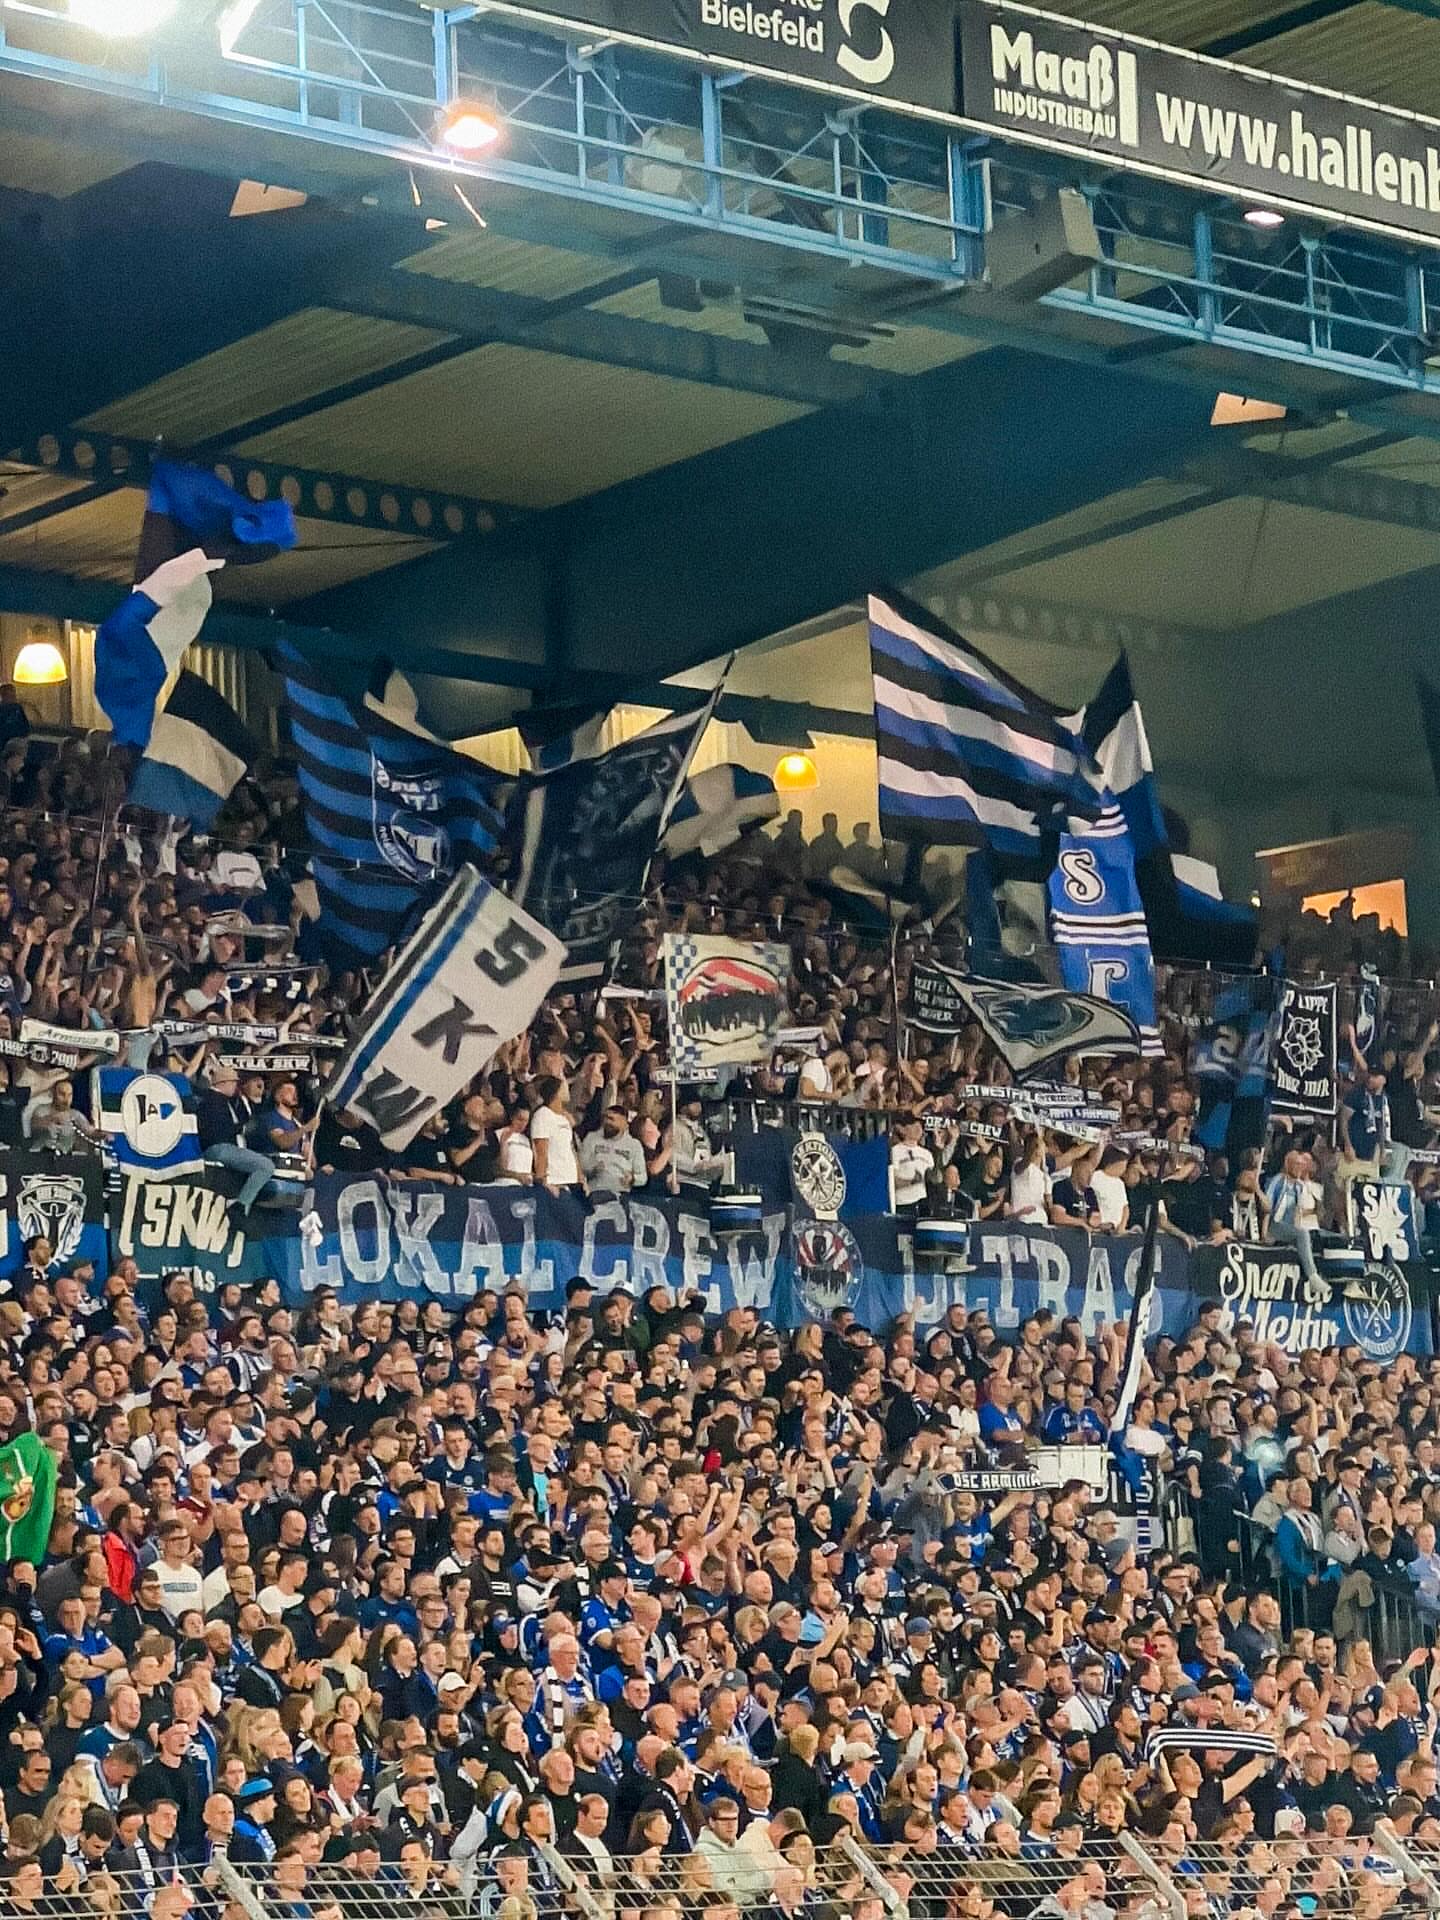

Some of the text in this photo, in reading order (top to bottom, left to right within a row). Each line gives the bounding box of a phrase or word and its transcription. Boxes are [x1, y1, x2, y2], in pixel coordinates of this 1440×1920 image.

[701, 0, 825, 53] Bielefeld
[990, 24, 1116, 110] Maaß
[993, 87, 1117, 139] INDUSTRIEBAU
[299, 1178, 555, 1296] LOKAL
[577, 1200, 788, 1309] CREW
[981, 1472, 1042, 1488] ARMINIA
